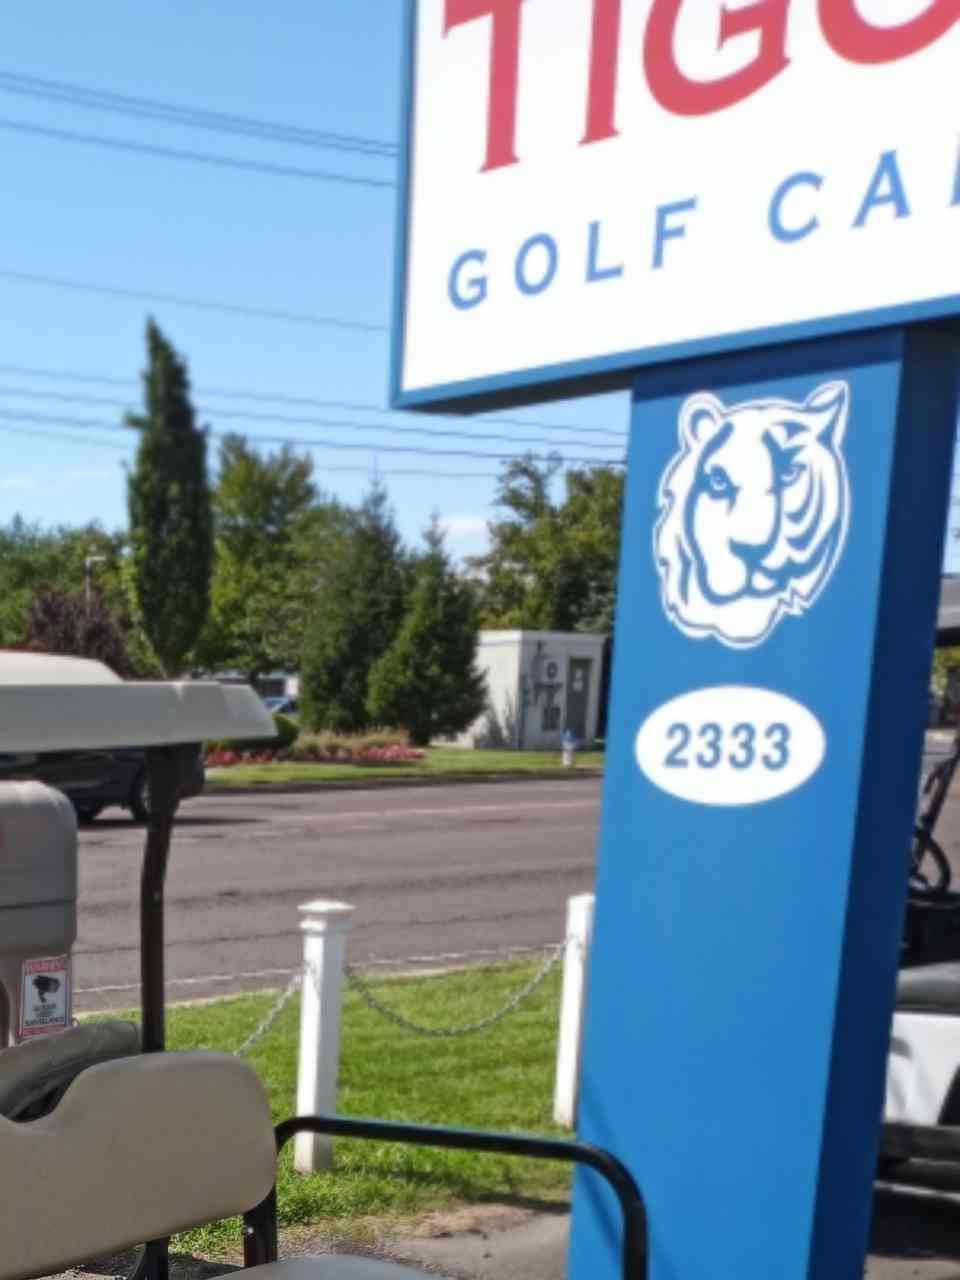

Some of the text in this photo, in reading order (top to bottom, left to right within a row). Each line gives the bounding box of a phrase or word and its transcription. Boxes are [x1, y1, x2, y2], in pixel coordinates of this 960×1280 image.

[448, 131, 960, 311] GOLF CA
[664, 722, 791, 771] 2333
